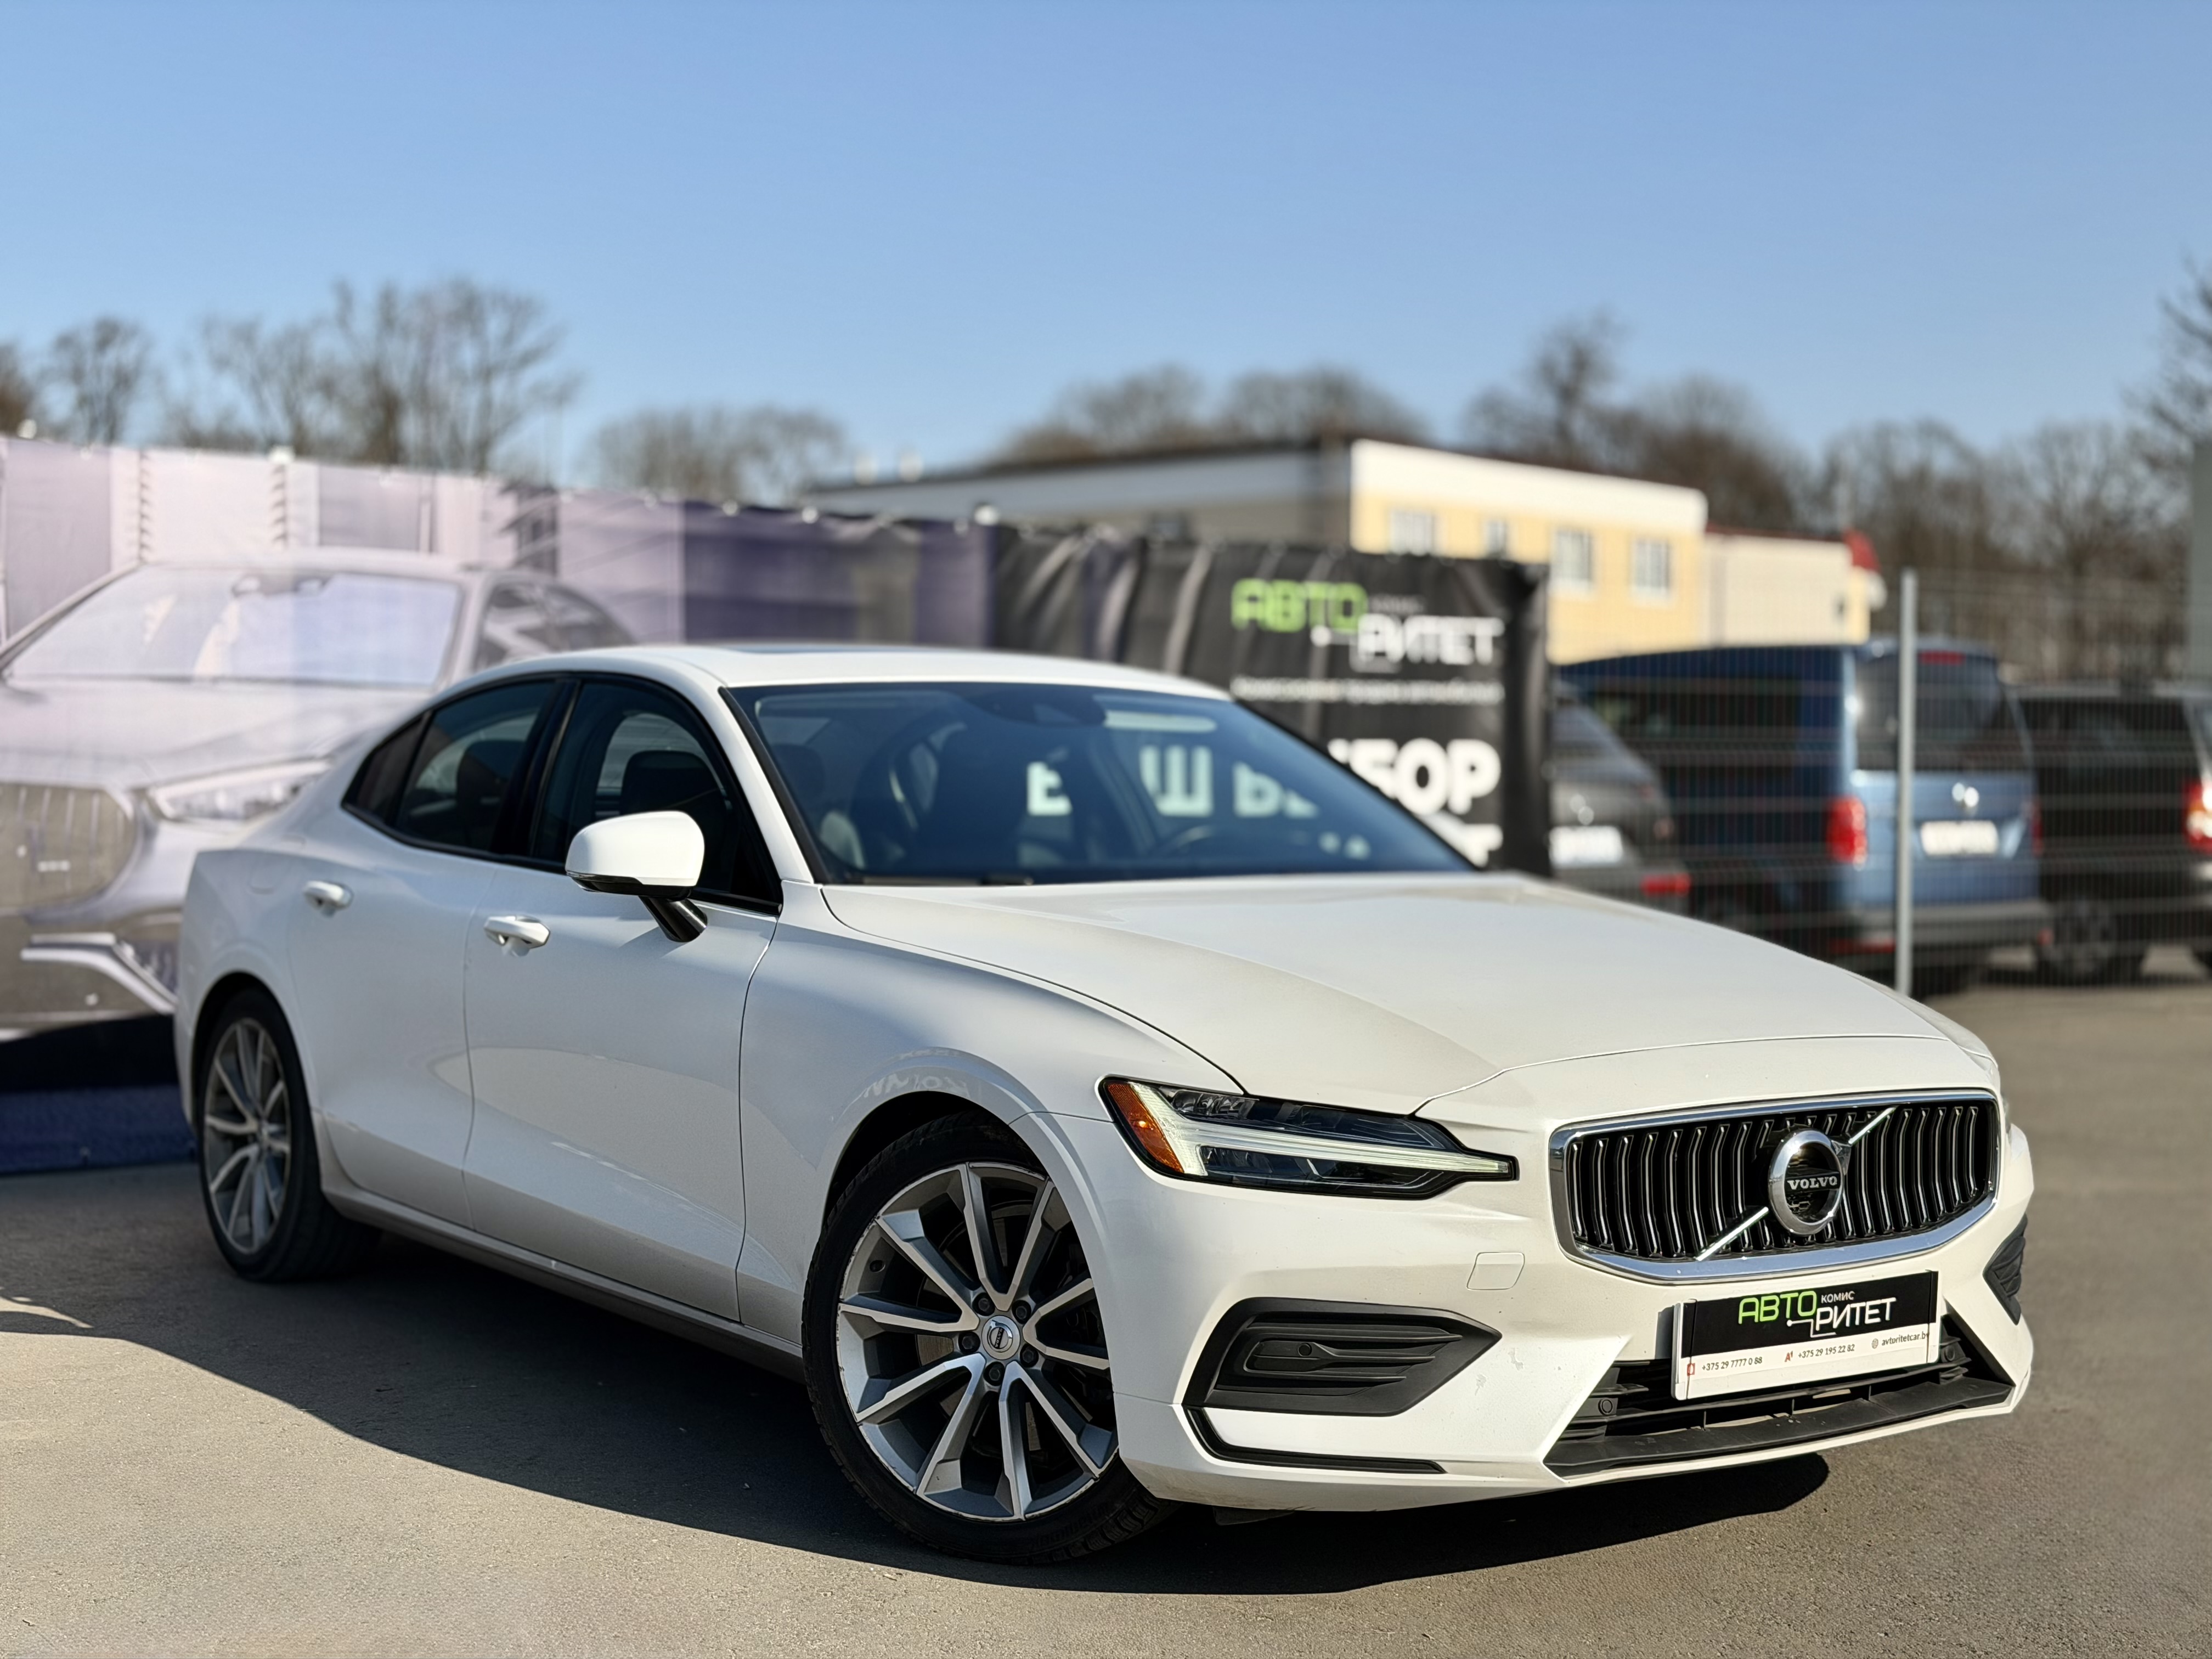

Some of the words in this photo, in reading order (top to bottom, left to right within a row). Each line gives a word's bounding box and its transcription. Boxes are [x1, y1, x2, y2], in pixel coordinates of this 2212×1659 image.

[1787, 1176, 1838, 1190] VOLVO
[1821, 1291, 1855, 1304] КОМИС
[1739, 1290, 1817, 1324] АВТО
[1816, 1297, 1897, 1331] РИТЕТ
[1798, 1350, 1814, 1358] +375
[1815, 1348, 1824, 1357] 29
[1825, 1346, 1837, 1355] 195
[1838, 1345, 1846, 1353] 22
[1847, 1344, 1855, 1352] 82
[1702, 1362, 1719, 1371] +375
[1720, 1361, 1729, 1369] 29
[1731, 1358, 1747, 1368] 7777
